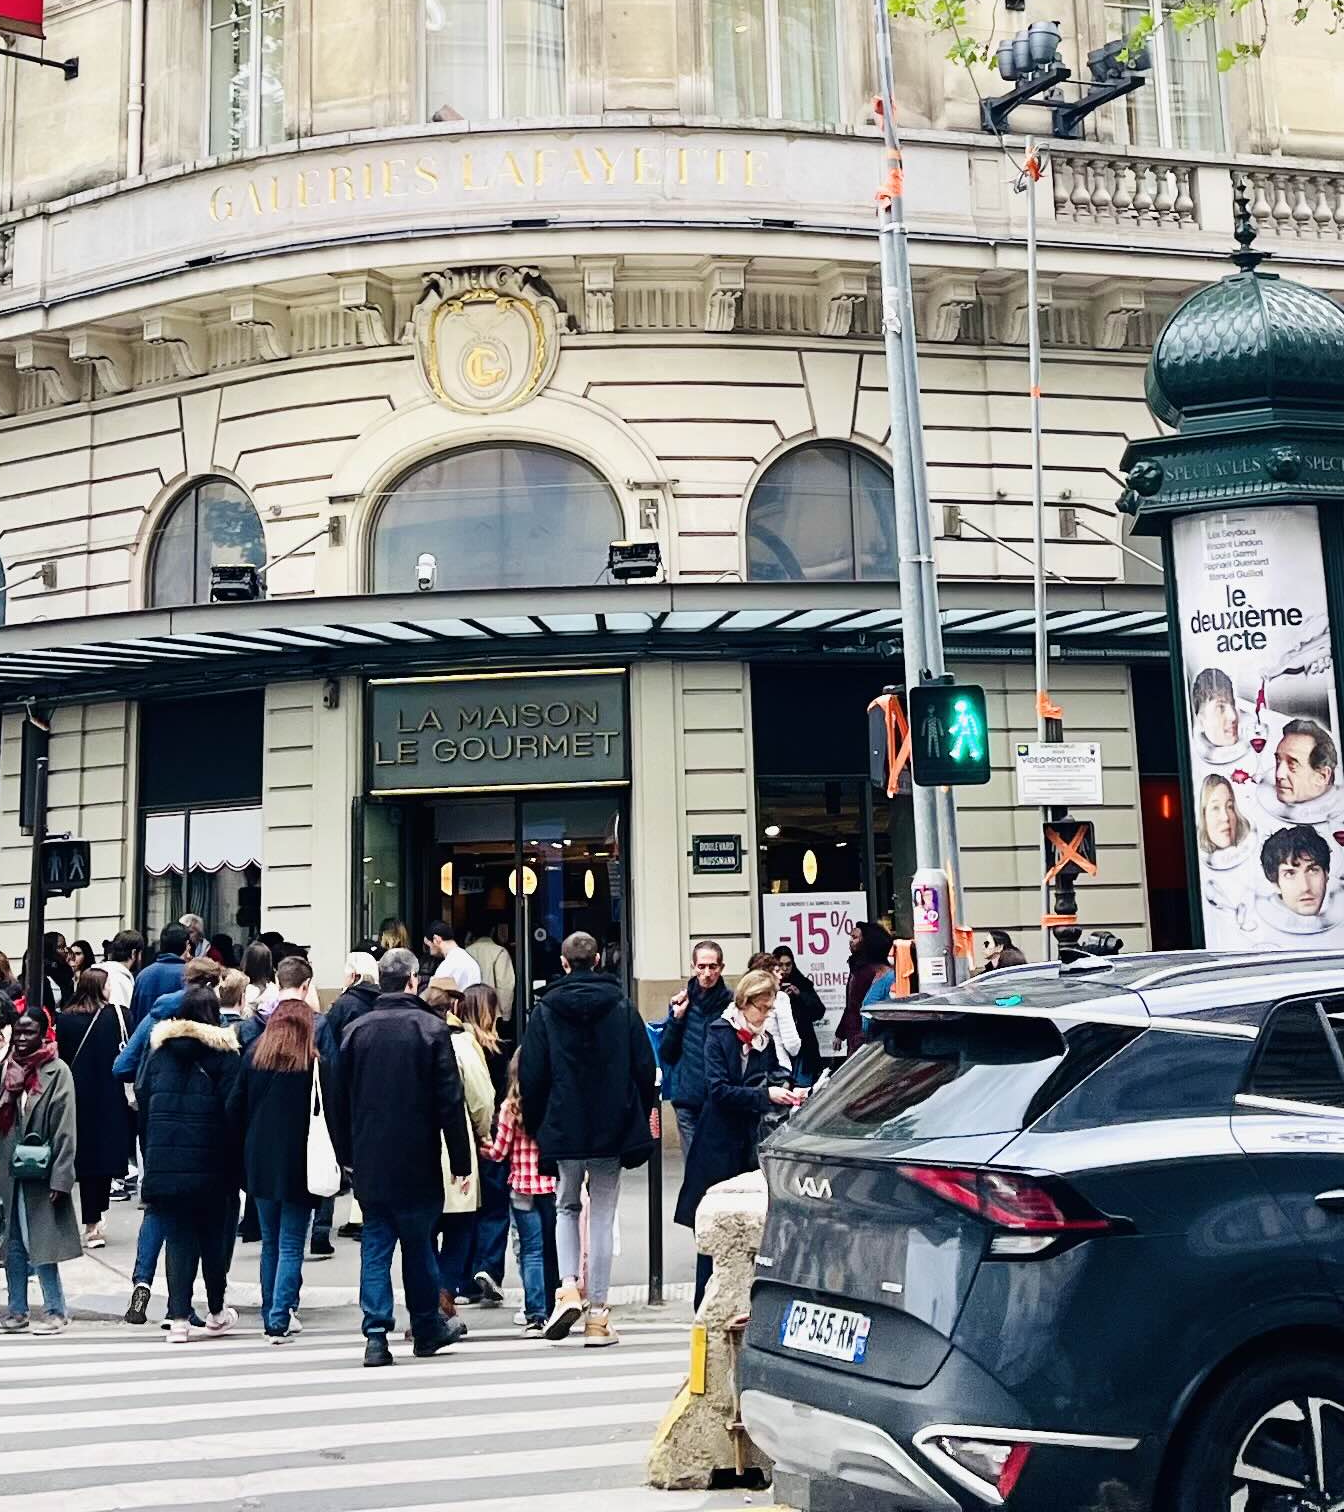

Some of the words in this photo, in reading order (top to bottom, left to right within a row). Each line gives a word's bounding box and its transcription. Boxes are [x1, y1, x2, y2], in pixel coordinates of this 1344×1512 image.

[208, 155, 440, 224] GALERIES
[462, 145, 772, 191] LAFAYETTE
[1164, 456, 1262, 482] SPECTACLES
[1226, 584, 1246, 607] le
[1190, 604, 1303, 634] deuxième
[1216, 630, 1267, 653] acte
[397, 709, 444, 734] LA
[457, 700, 599, 731] MAISON
[373, 740, 419, 767] LE
[432, 731, 621, 763] GOURMET
[698, 855, 736, 866] HAUSSMANN
[699, 841, 735, 852] BOULEVARD
[779, 910, 853, 956] -15%
[794, 1176, 832, 1199] KIA
[789, 1305, 860, 1349] GP-545-RW
